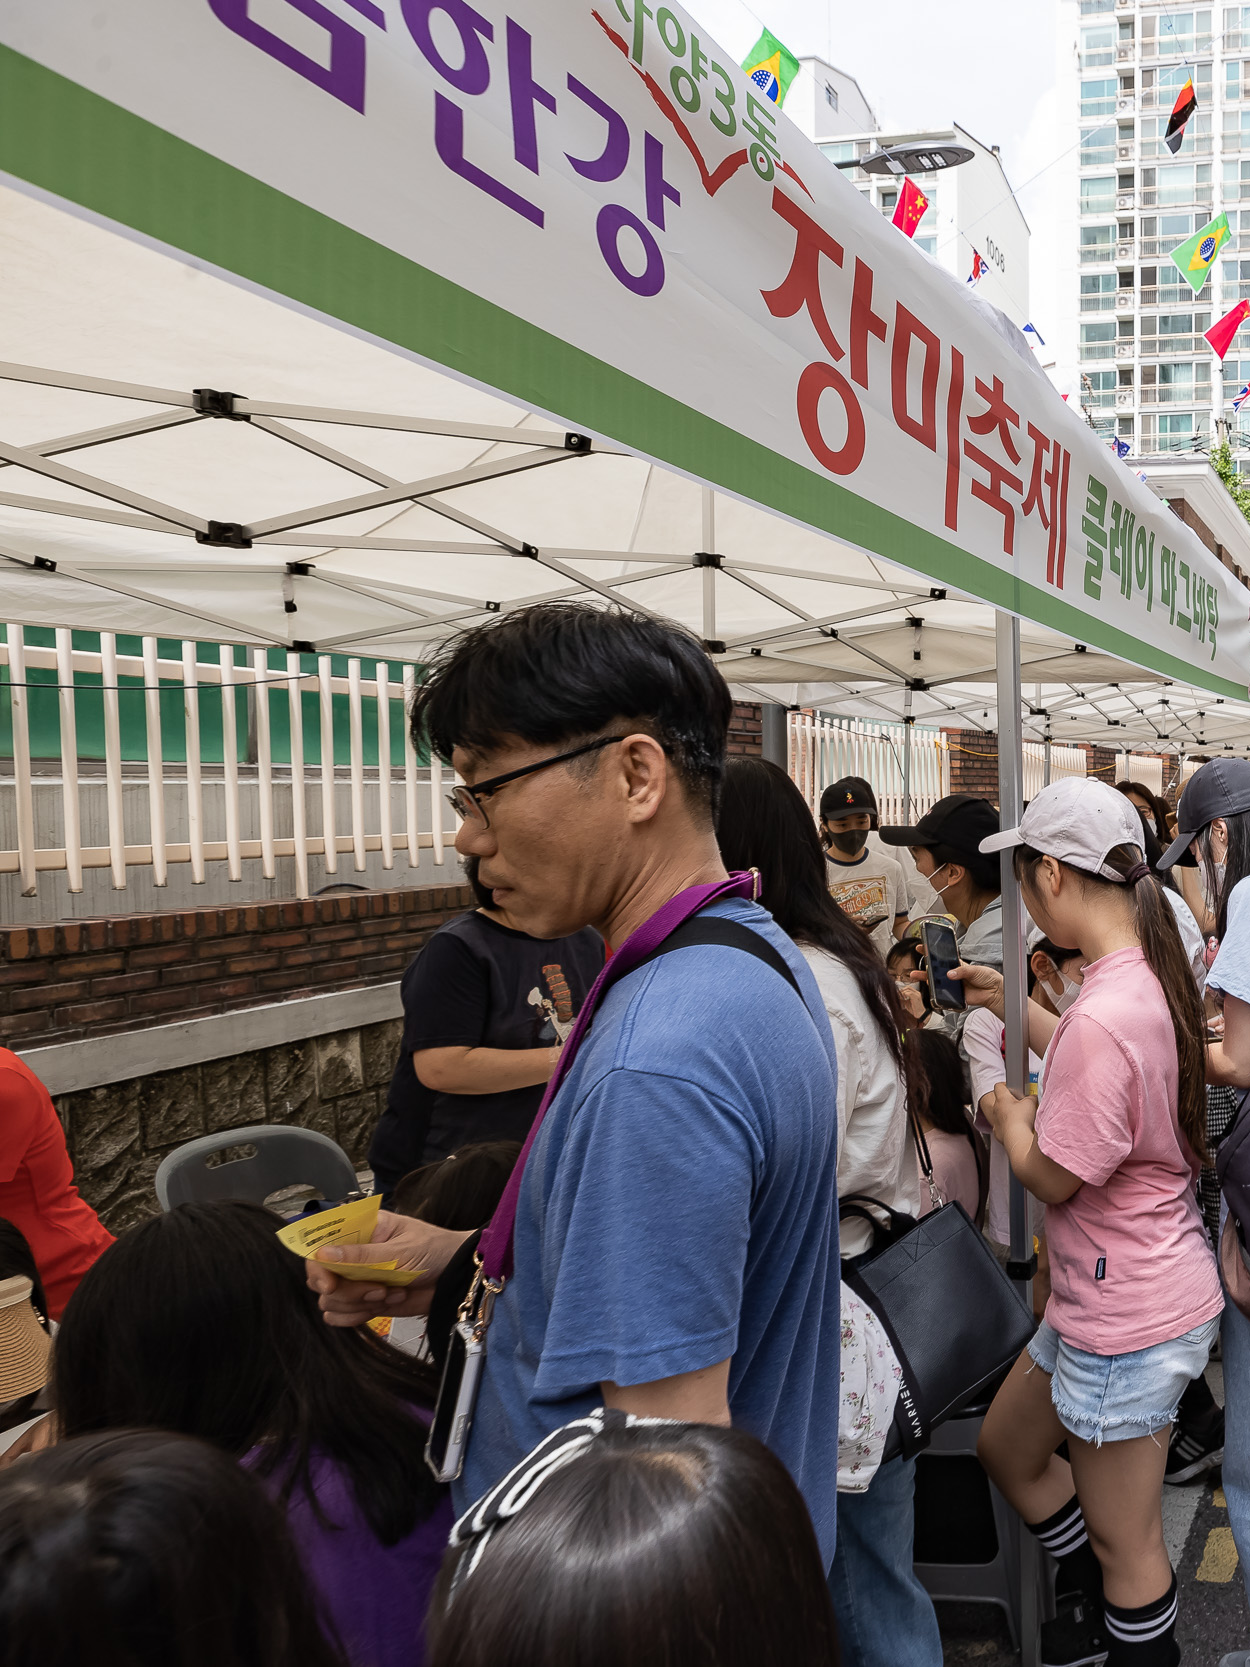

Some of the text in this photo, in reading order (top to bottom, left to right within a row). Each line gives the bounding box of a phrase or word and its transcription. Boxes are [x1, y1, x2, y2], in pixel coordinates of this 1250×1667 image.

[986, 235, 1006, 273] 1008
[759, 186, 1071, 591] 장미축제
[1081, 474, 1155, 613] 클레이
[1161, 544, 1220, 661] 마그네틱
